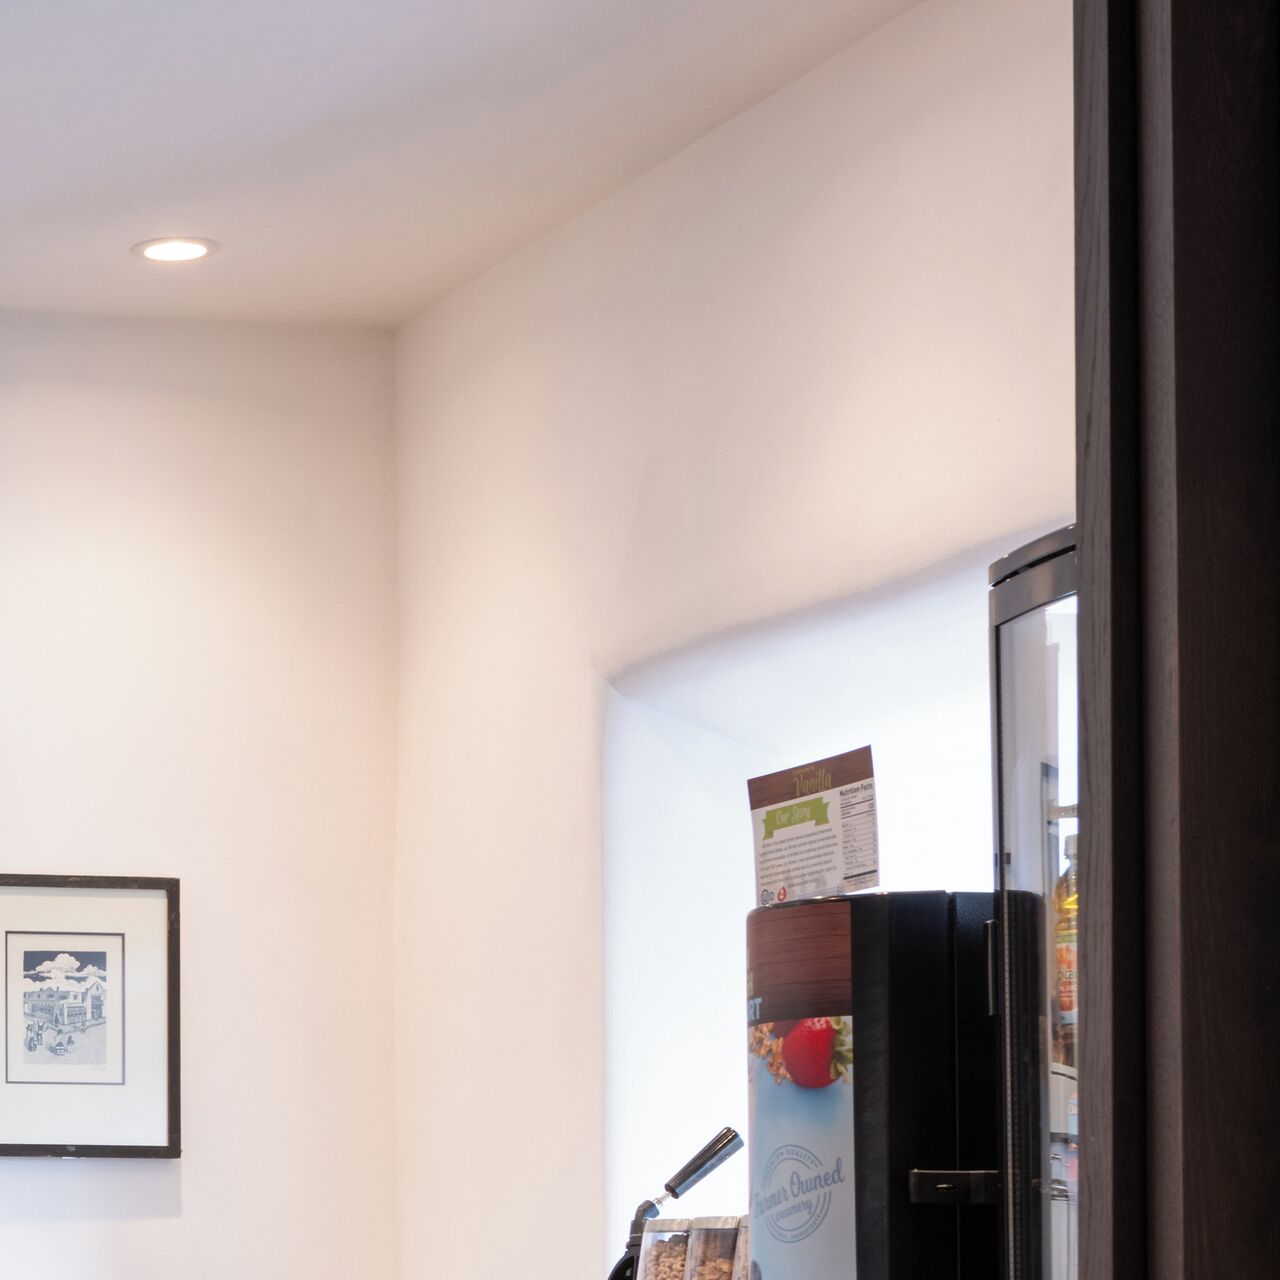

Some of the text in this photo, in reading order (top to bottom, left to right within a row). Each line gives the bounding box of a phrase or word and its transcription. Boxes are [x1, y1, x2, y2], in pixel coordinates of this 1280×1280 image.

[793, 768, 832, 796] Vanilla
[839, 786, 860, 796] Nutrition
[754, 1156, 846, 1218] Farmer Owned
